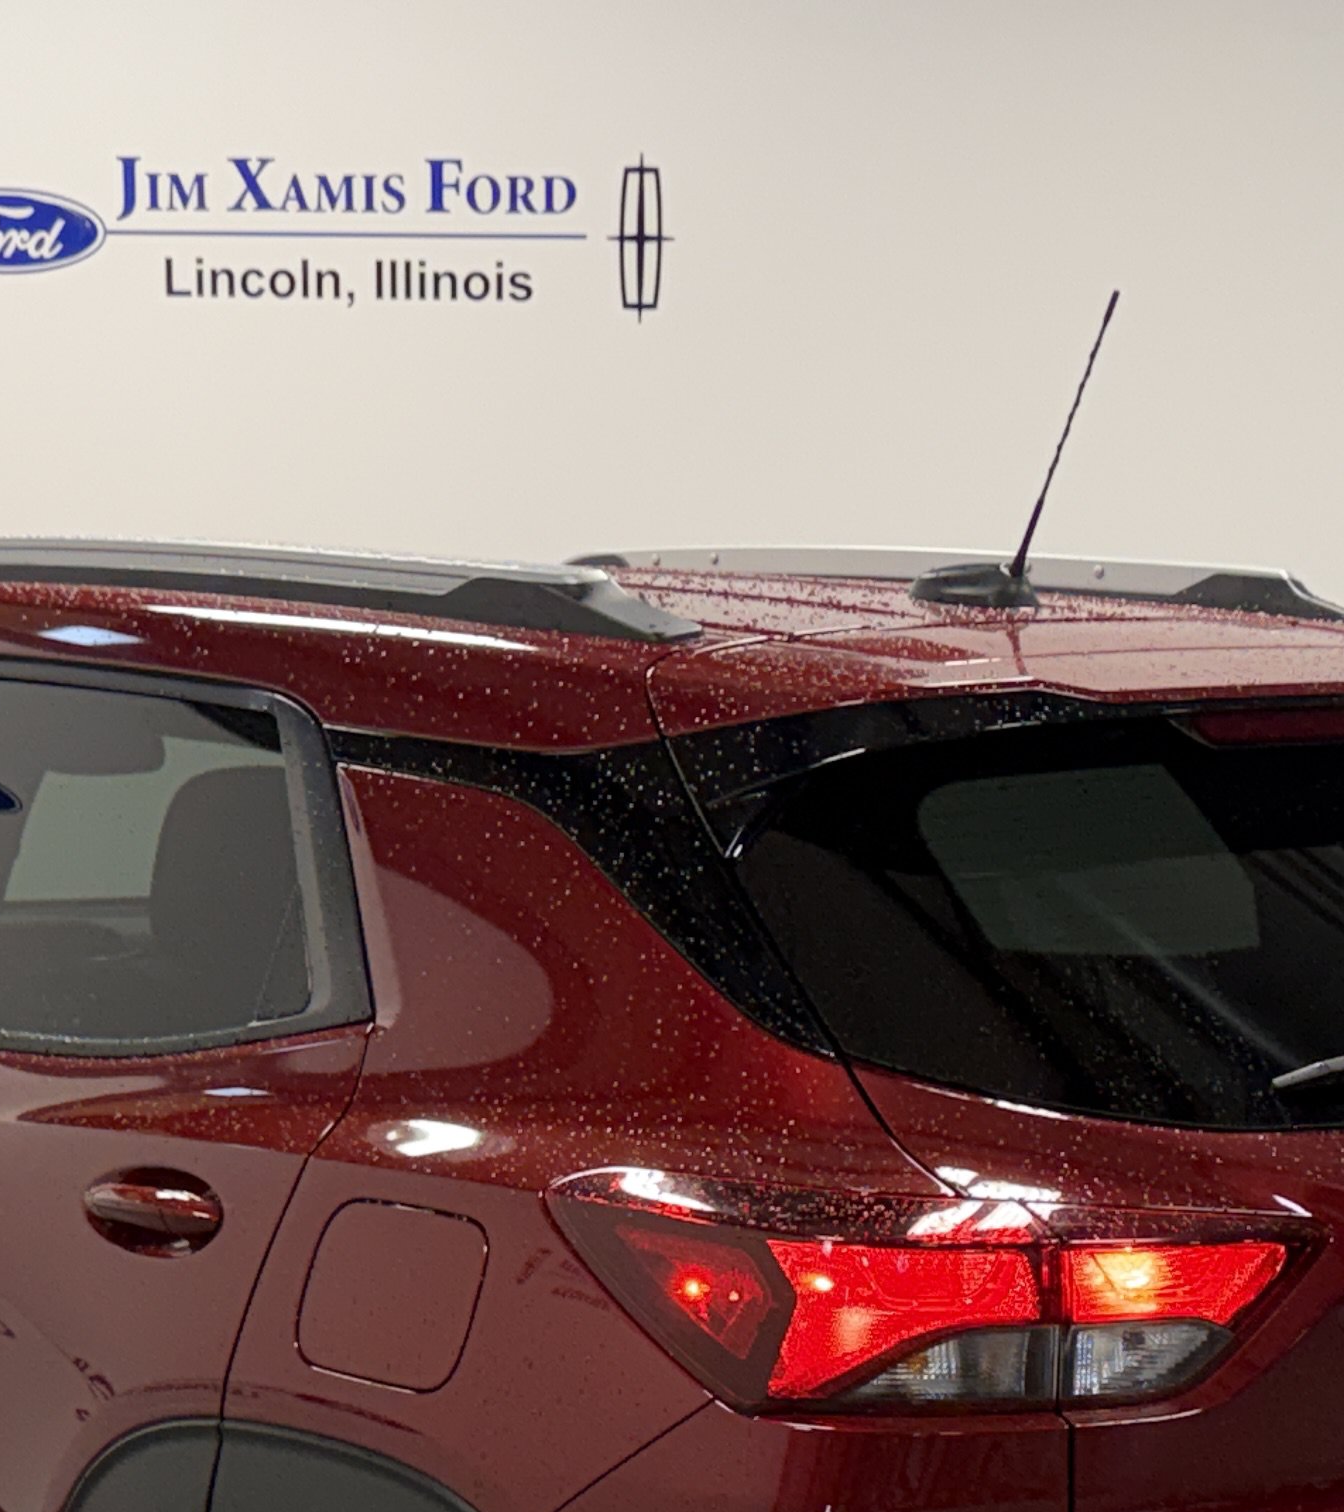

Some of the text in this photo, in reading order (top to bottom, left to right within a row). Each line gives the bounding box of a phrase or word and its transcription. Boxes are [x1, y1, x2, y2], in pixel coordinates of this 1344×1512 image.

[116, 156, 577, 221] JIM XAMIS FORD
[165, 257, 533, 308] Lincoln, Illinois
